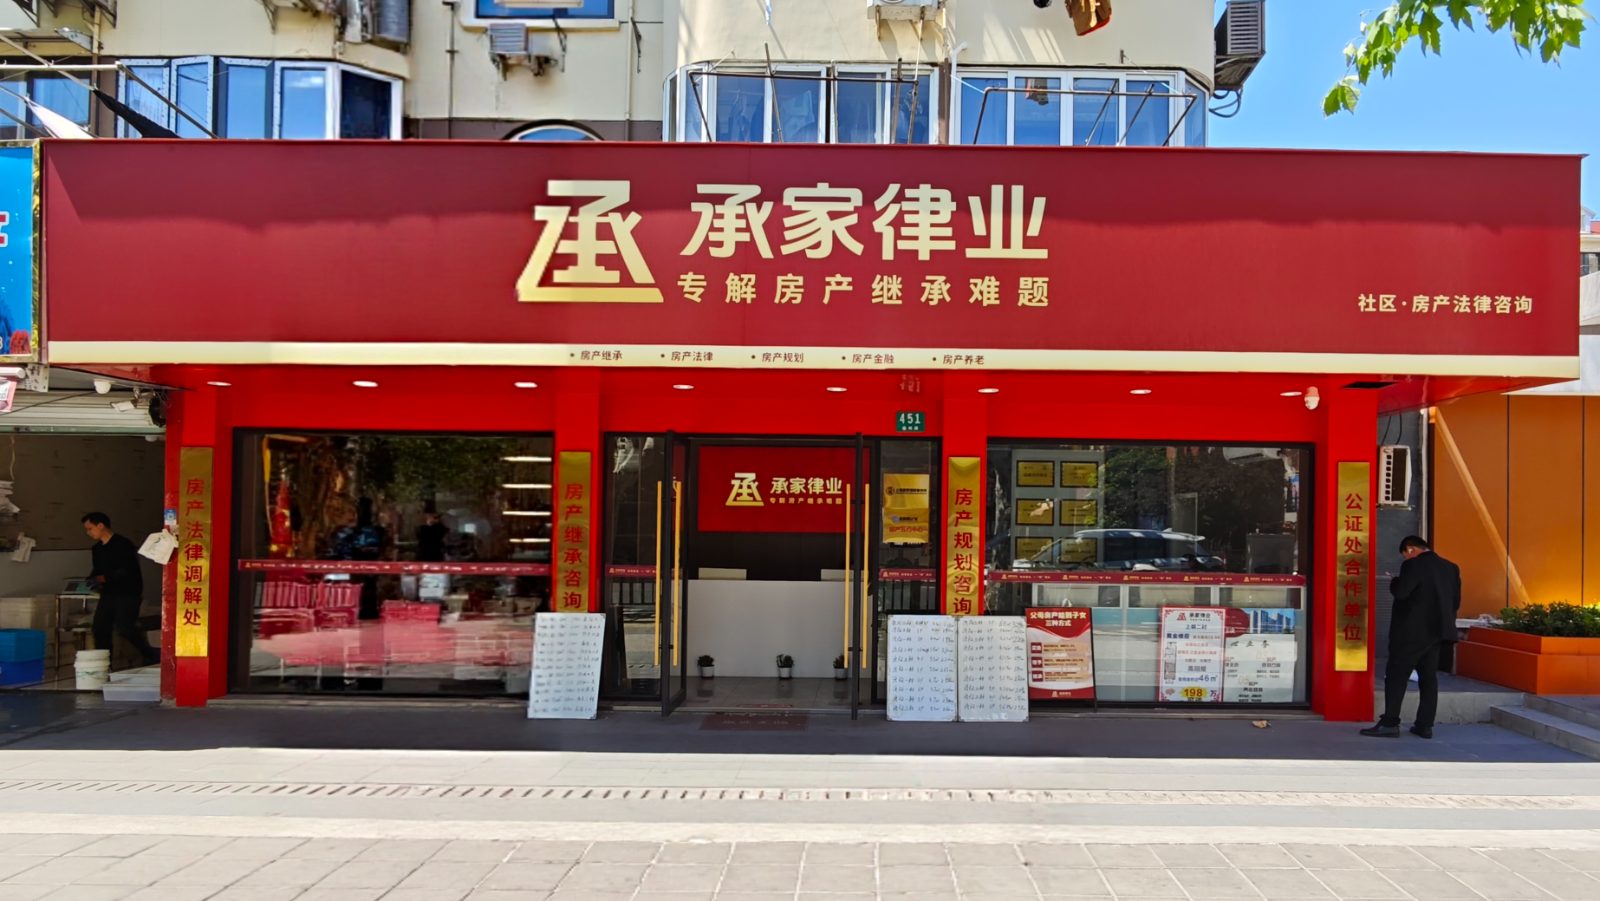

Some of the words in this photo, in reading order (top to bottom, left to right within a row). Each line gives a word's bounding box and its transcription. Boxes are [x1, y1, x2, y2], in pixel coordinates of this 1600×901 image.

[680, 183, 1049, 261] 承家律业
[677, 272, 1050, 307] 专解房产继承难题
[1358, 293, 1533, 314] 社区·房产法律咨询
[580, 350, 623, 361] 房产继承
[671, 351, 714, 362] 房产法律
[761, 352, 804, 363] 房产规划
[852, 353, 895, 365] 房产金融
[943, 354, 985, 366] 房产养老
[899, 413, 921, 424] 451
[770, 477, 843, 495] 承家律业
[183, 477, 205, 626] 房产法律调解处
[562, 483, 585, 609] 房产继承咨询
[953, 488, 974, 616] 房产规划咨询
[1342, 493, 1364, 642] 公证处合作单位
[1183, 688, 1203, 698] 198
